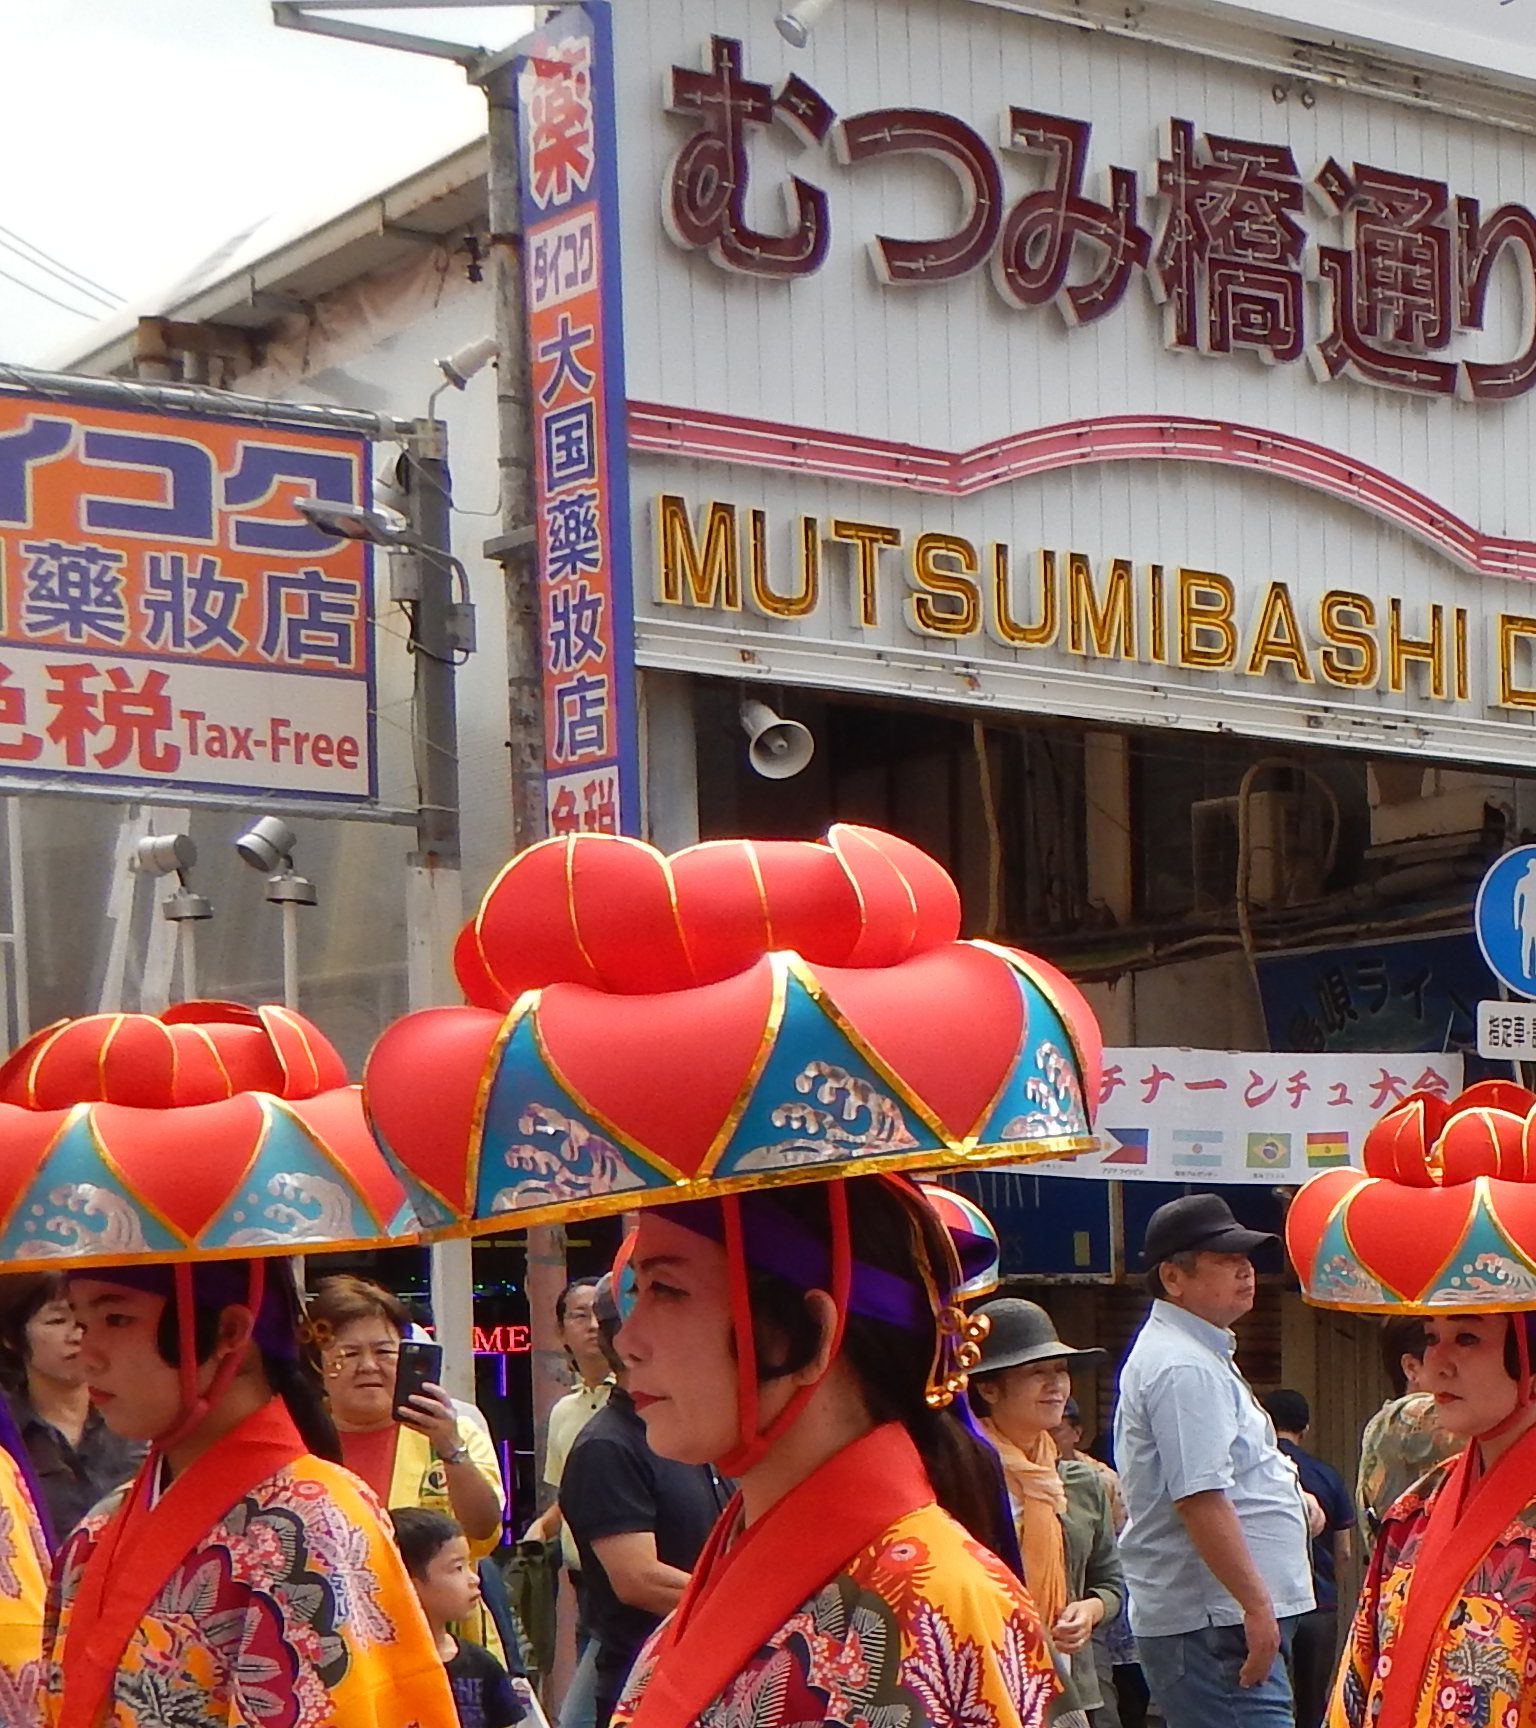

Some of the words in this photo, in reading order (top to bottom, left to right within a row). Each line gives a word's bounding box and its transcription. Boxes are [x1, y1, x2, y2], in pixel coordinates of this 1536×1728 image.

[534, 223, 593, 302] ダイコク
[0, 539, 358, 666] 藥妝店
[658, 493, 1471, 702] MUTSUMIBASHI
[180, 710, 360, 770] Tax-Free
